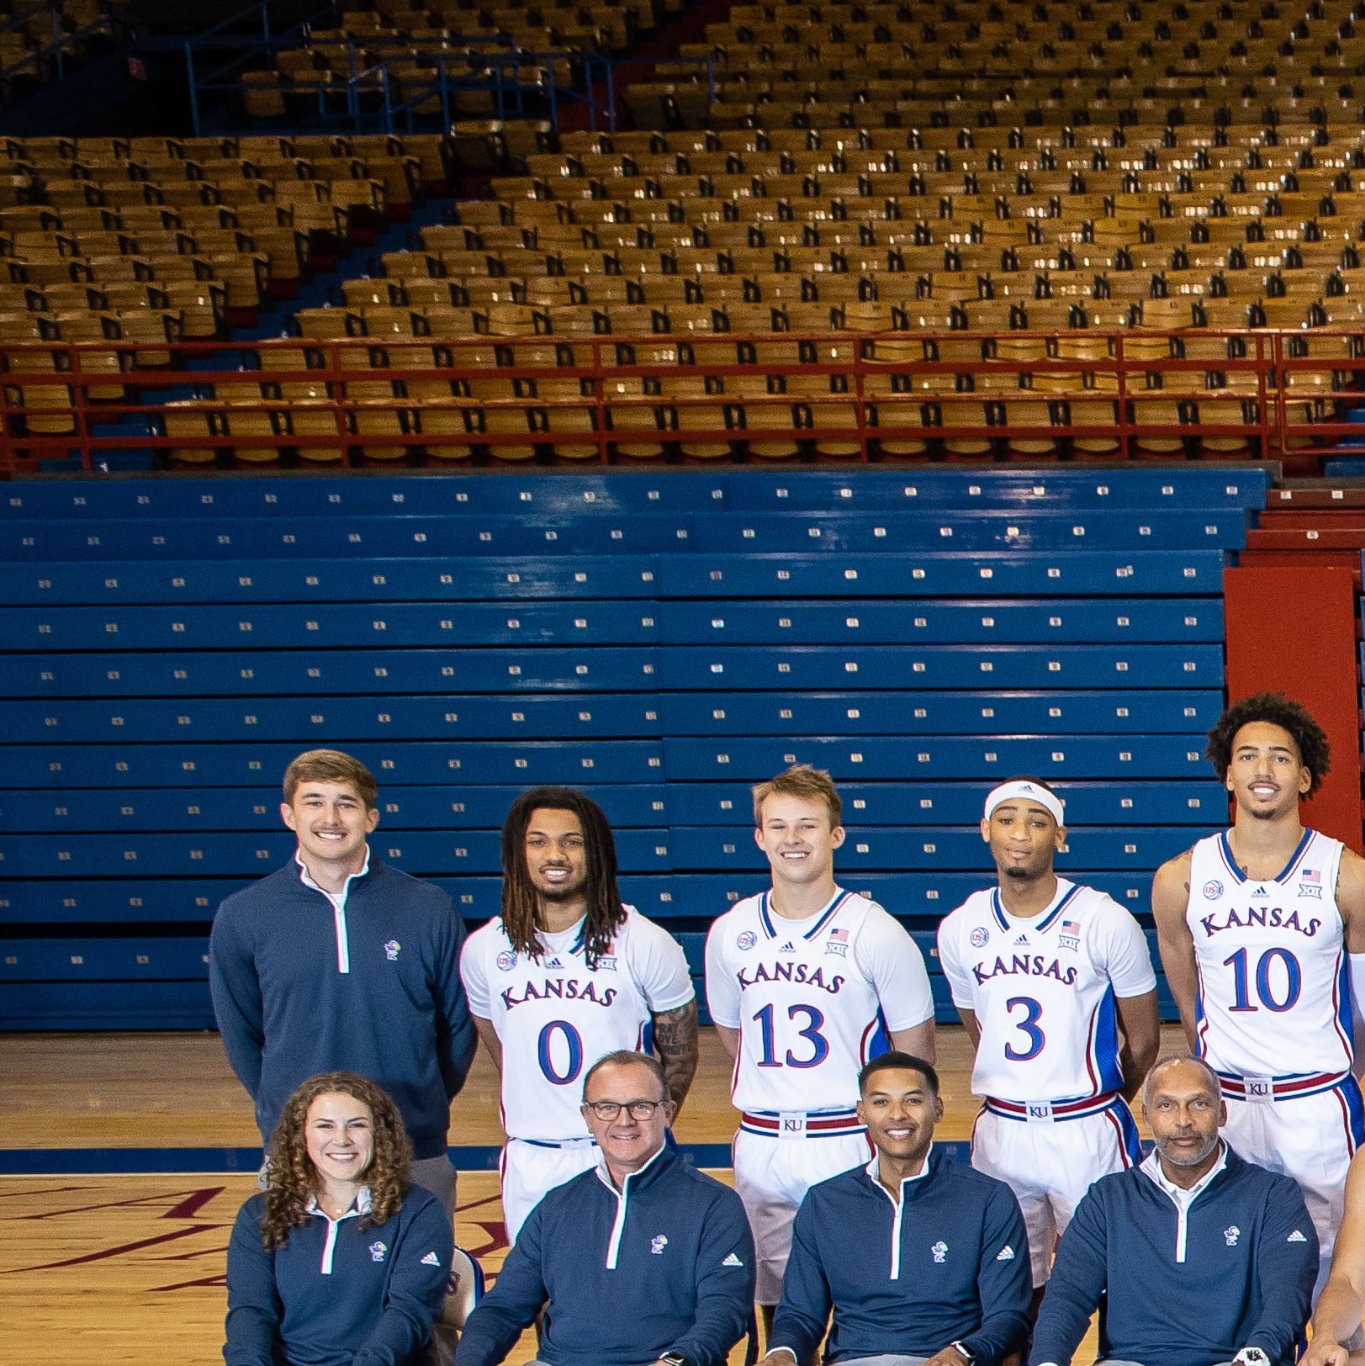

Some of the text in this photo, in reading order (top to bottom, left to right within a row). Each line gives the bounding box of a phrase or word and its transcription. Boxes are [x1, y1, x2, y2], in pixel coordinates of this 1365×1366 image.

[1200, 907, 1321, 937] KANSAS
[737, 961, 845, 994] KANSAS
[971, 954, 1077, 986] KANSAS
[1223, 947, 1302, 1013] 10
[500, 979, 617, 1011] KANSAS
[753, 1003, 830, 1068] 13
[1005, 996, 1045, 1061] 3
[538, 1020, 583, 1085] 0
[1249, 1083, 1268, 1097] KU
[784, 1119, 804, 1132] KU
[1029, 1106, 1049, 1119] KU
